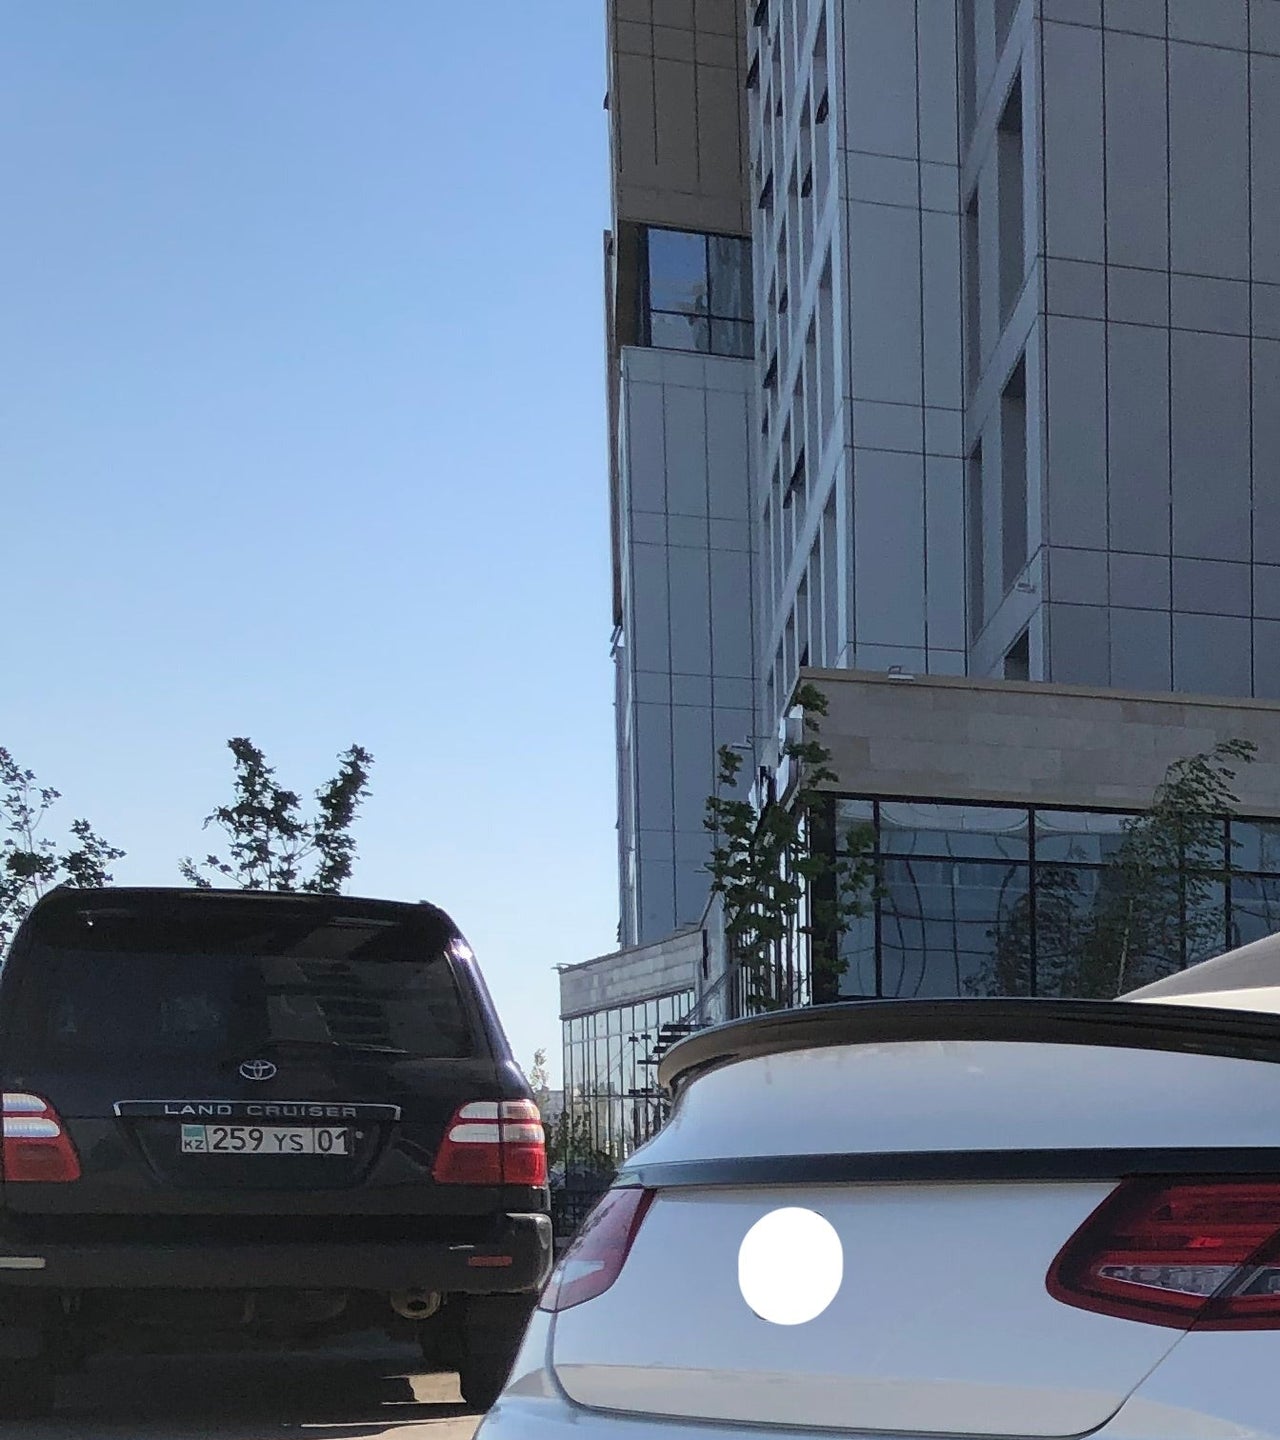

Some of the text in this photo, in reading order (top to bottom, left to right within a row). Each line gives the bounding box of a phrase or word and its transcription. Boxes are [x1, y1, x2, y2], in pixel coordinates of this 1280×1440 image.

[164, 1104, 357, 1117] LAND CRUISER
[184, 1127, 348, 1153] KZ 259 YS 01
